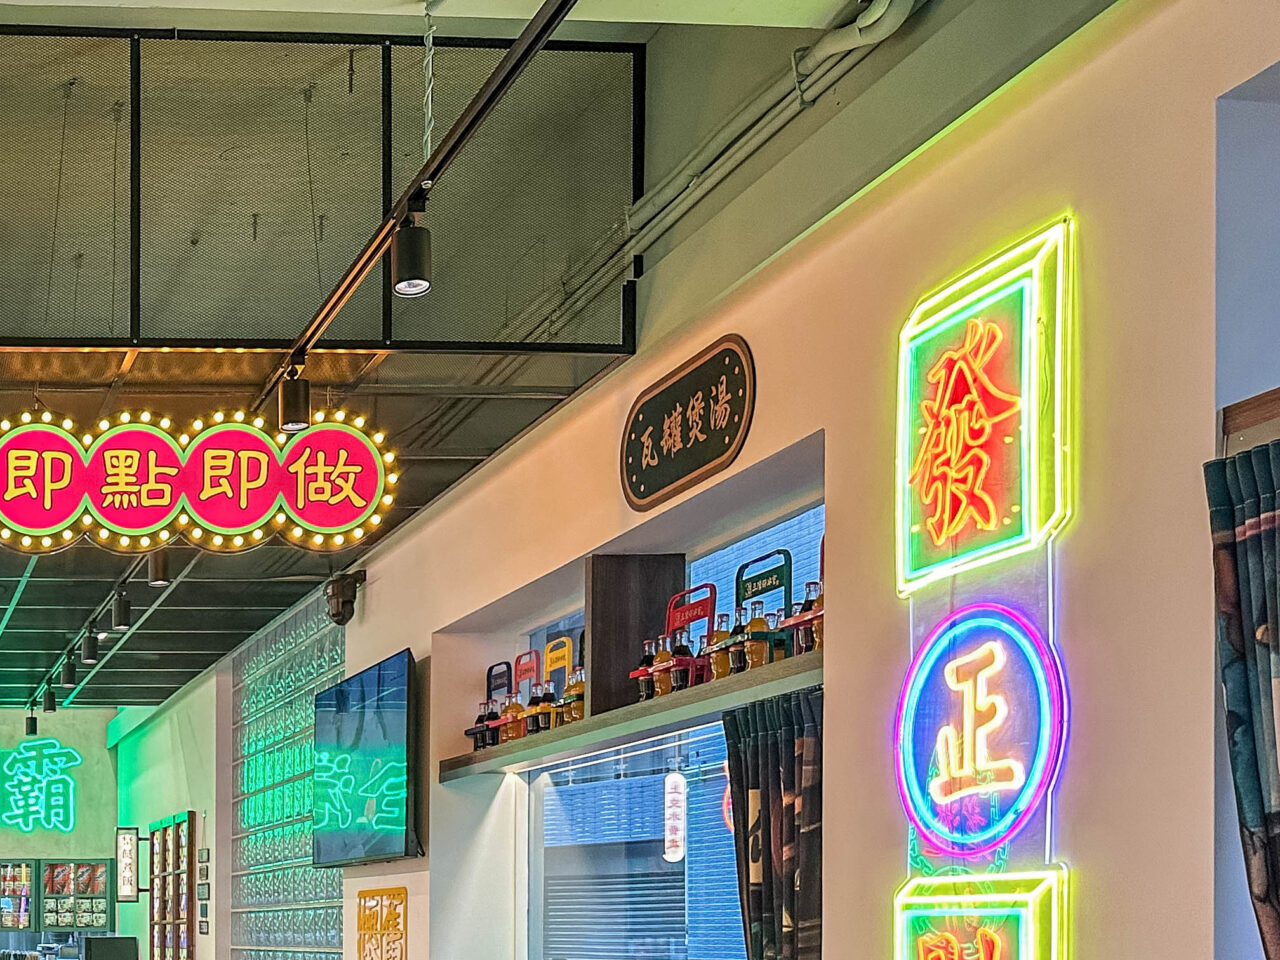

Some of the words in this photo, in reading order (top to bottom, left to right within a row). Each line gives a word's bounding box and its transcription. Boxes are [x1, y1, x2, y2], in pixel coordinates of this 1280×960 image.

[640, 375, 732, 470] 瓦罐煲湯
[3, 447, 367, 510] 即點即做
